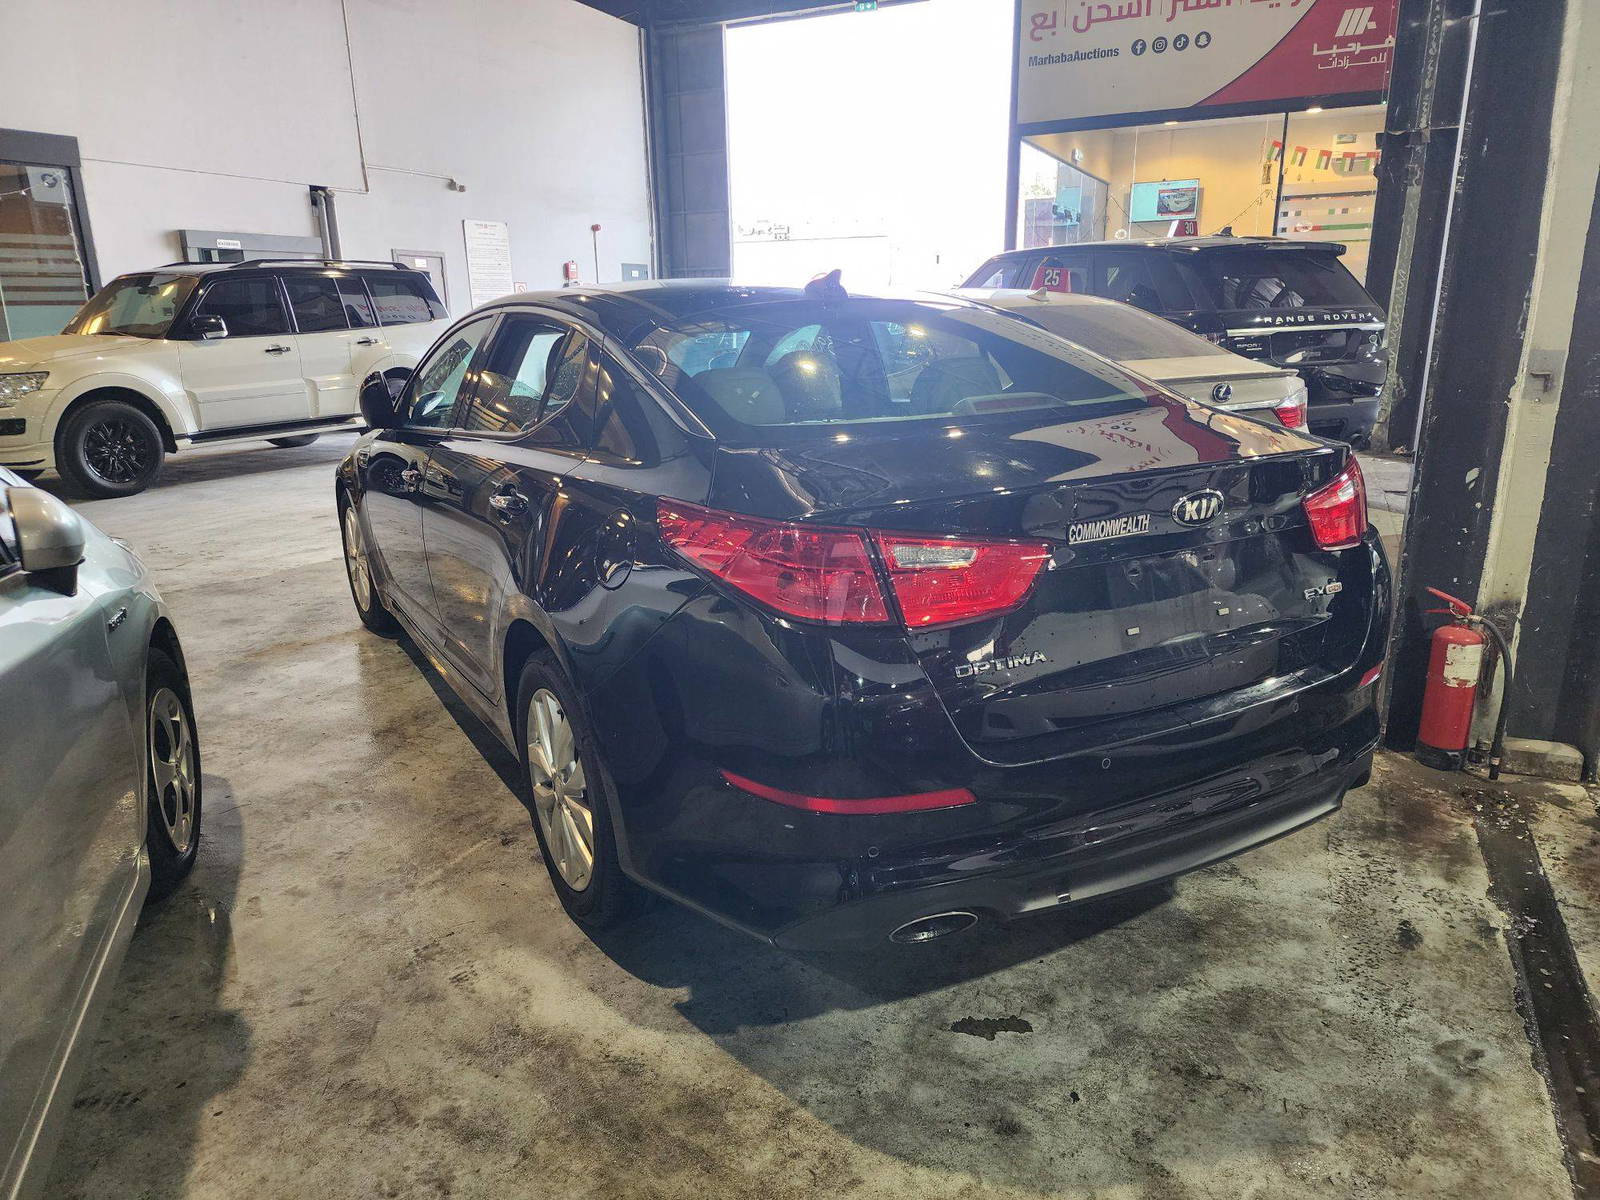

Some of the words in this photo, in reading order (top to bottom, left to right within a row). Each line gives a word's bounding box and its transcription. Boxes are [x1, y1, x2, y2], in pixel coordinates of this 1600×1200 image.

[1028, 47, 1120, 67] MarhabaAuctions
[1184, 221, 1194, 235] 30
[1044, 269, 1061, 286] 25
[1263, 315, 1315, 324] RANGE
[1323, 312, 1366, 321] ROVER
[1184, 498, 1219, 521] KIA
[1068, 514, 1150, 542] COMMONWEALTH
[955, 651, 1047, 678] OPTIMA
